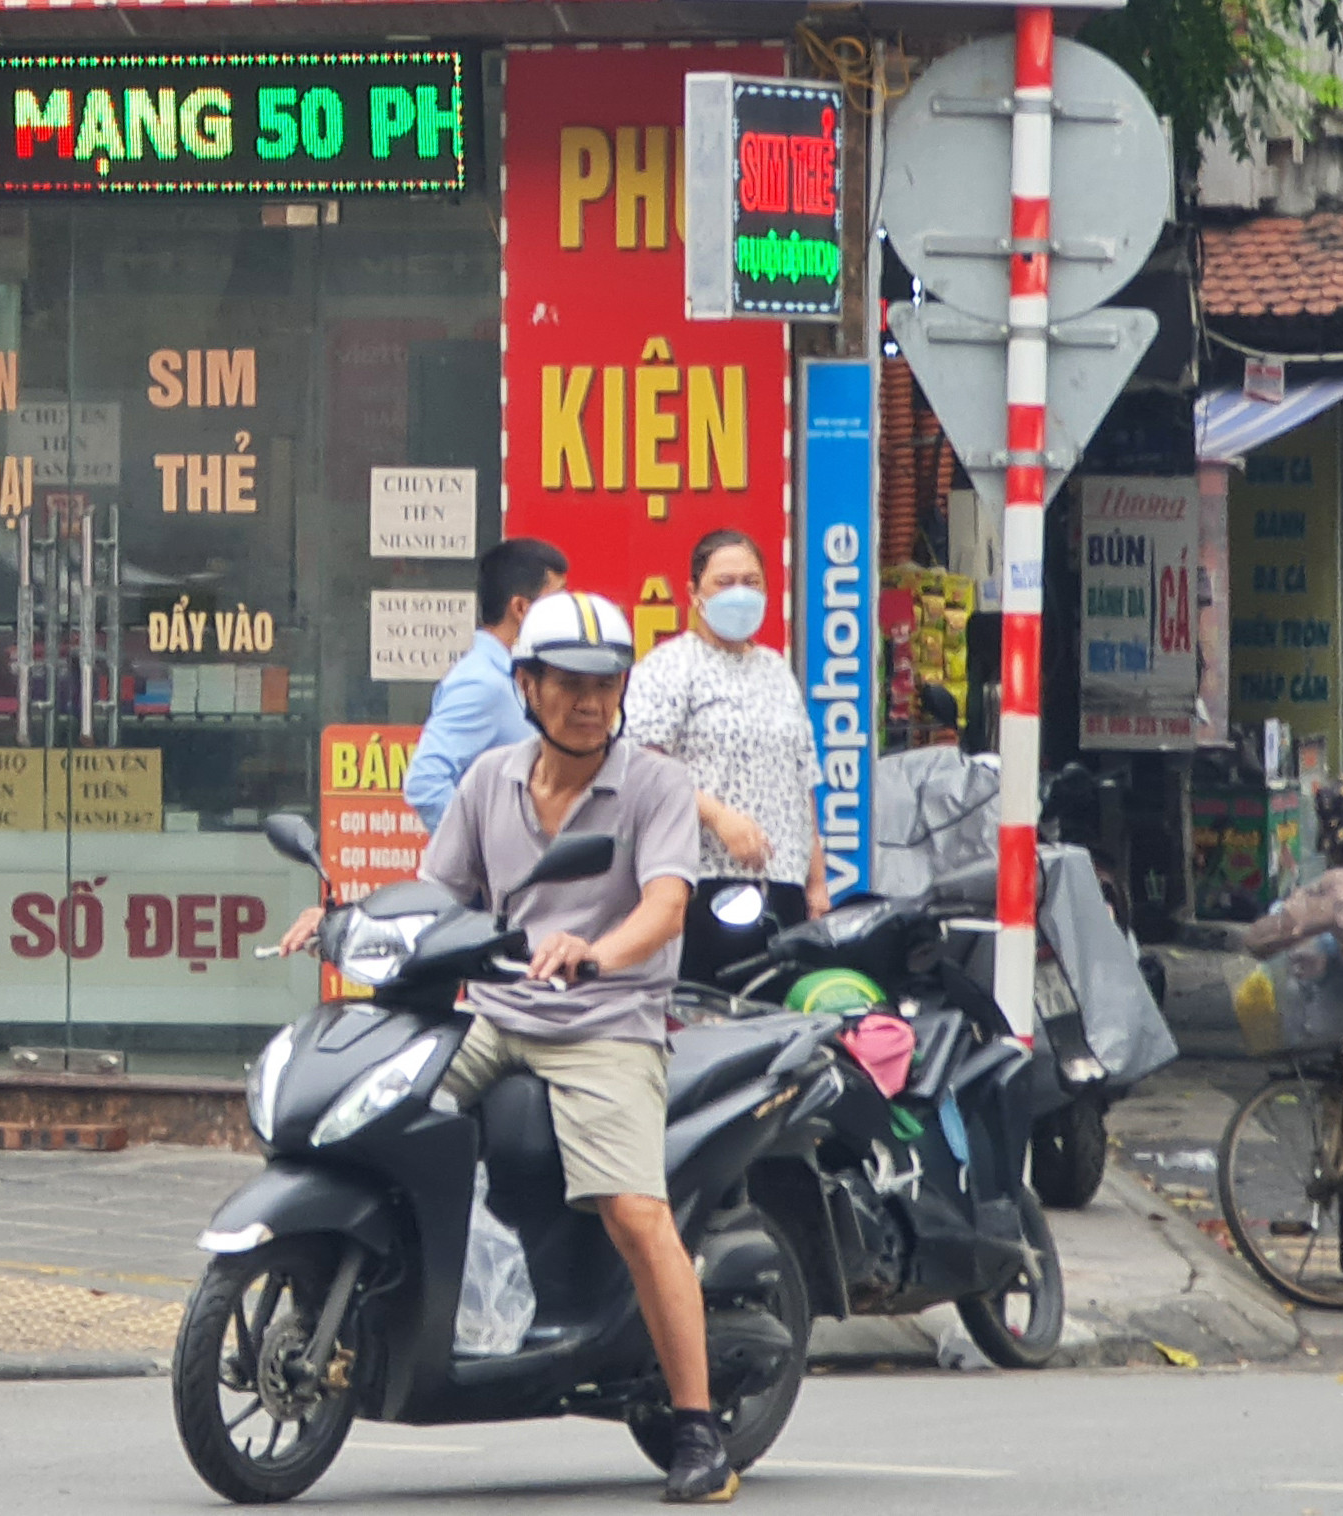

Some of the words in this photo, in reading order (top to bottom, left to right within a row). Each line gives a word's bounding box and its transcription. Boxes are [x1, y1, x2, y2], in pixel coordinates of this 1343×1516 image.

[14, 87, 233, 177] MẠNG
[256, 87, 344, 160] 50
[740, 130, 789, 213] SIM
[789, 106, 836, 216] THẺ
[560, 125, 686, 249] PH
[148, 348, 257, 410] SIM
[153, 427, 257, 514] THẺ
[541, 335, 749, 520] KIỆN
[380, 533, 437, 548] NHANH
[1088, 527, 1146, 567] BÚN
[148, 594, 207, 652] ĐẨY
[215, 602, 274, 652] VÀO
[1160, 544, 1192, 654] CÁ
[811, 522, 869, 900] vinaphone
[9, 876, 108, 960] SỐ
[124, 892, 267, 974] ĐẸP
